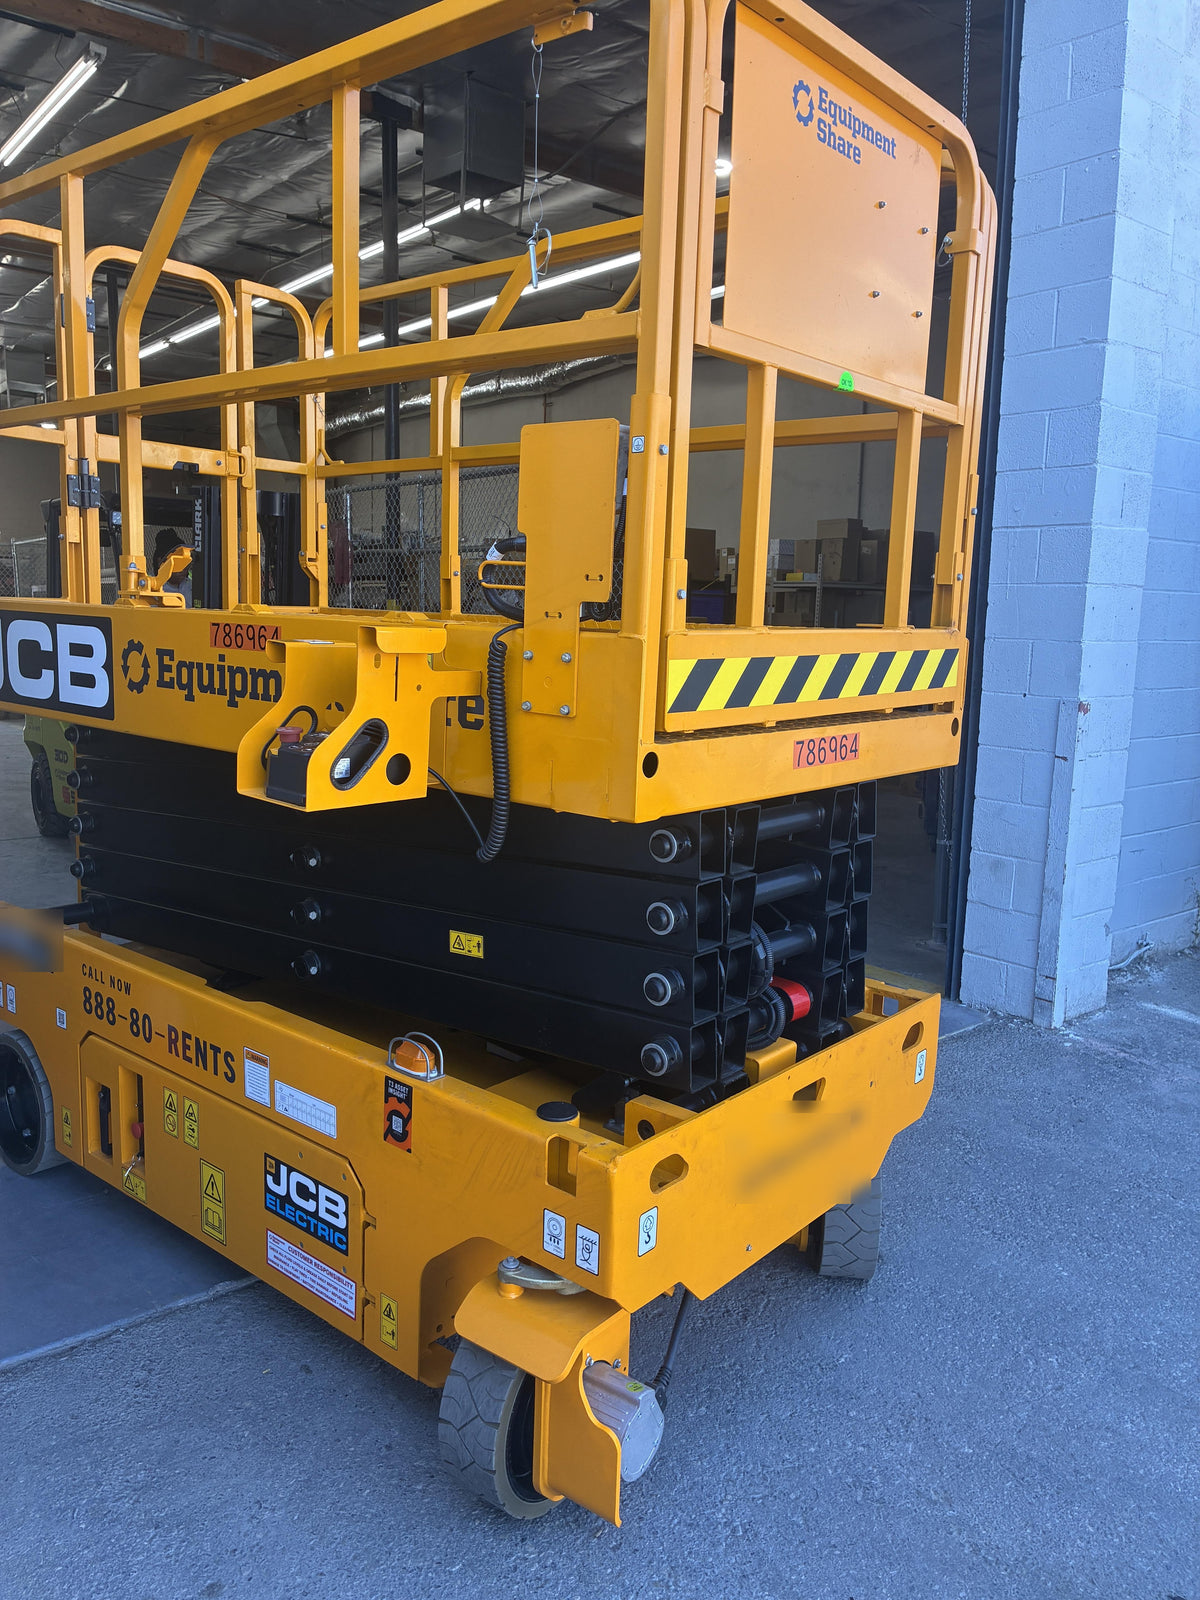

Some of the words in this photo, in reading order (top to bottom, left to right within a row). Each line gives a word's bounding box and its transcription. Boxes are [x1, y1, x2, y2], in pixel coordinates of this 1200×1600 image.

[817, 117, 861, 165] Share
[818, 85, 896, 160] Equipment
[194, 498, 202, 552] CLARK
[0, 619, 109, 708] CB
[156, 648, 282, 708] Equipm
[796, 733, 858, 767] 786964
[82, 963, 105, 985] CALL
[110, 975, 132, 996] NOW
[83, 986, 236, 1084] 888-80-RENTS
[266, 1164, 347, 1229] JCB
[266, 1193, 347, 1251] ELECTRIC
[288, 1245, 313, 1265] CUSTOMER
[314, 1260, 352, 1289] RESPONSIBILITY
